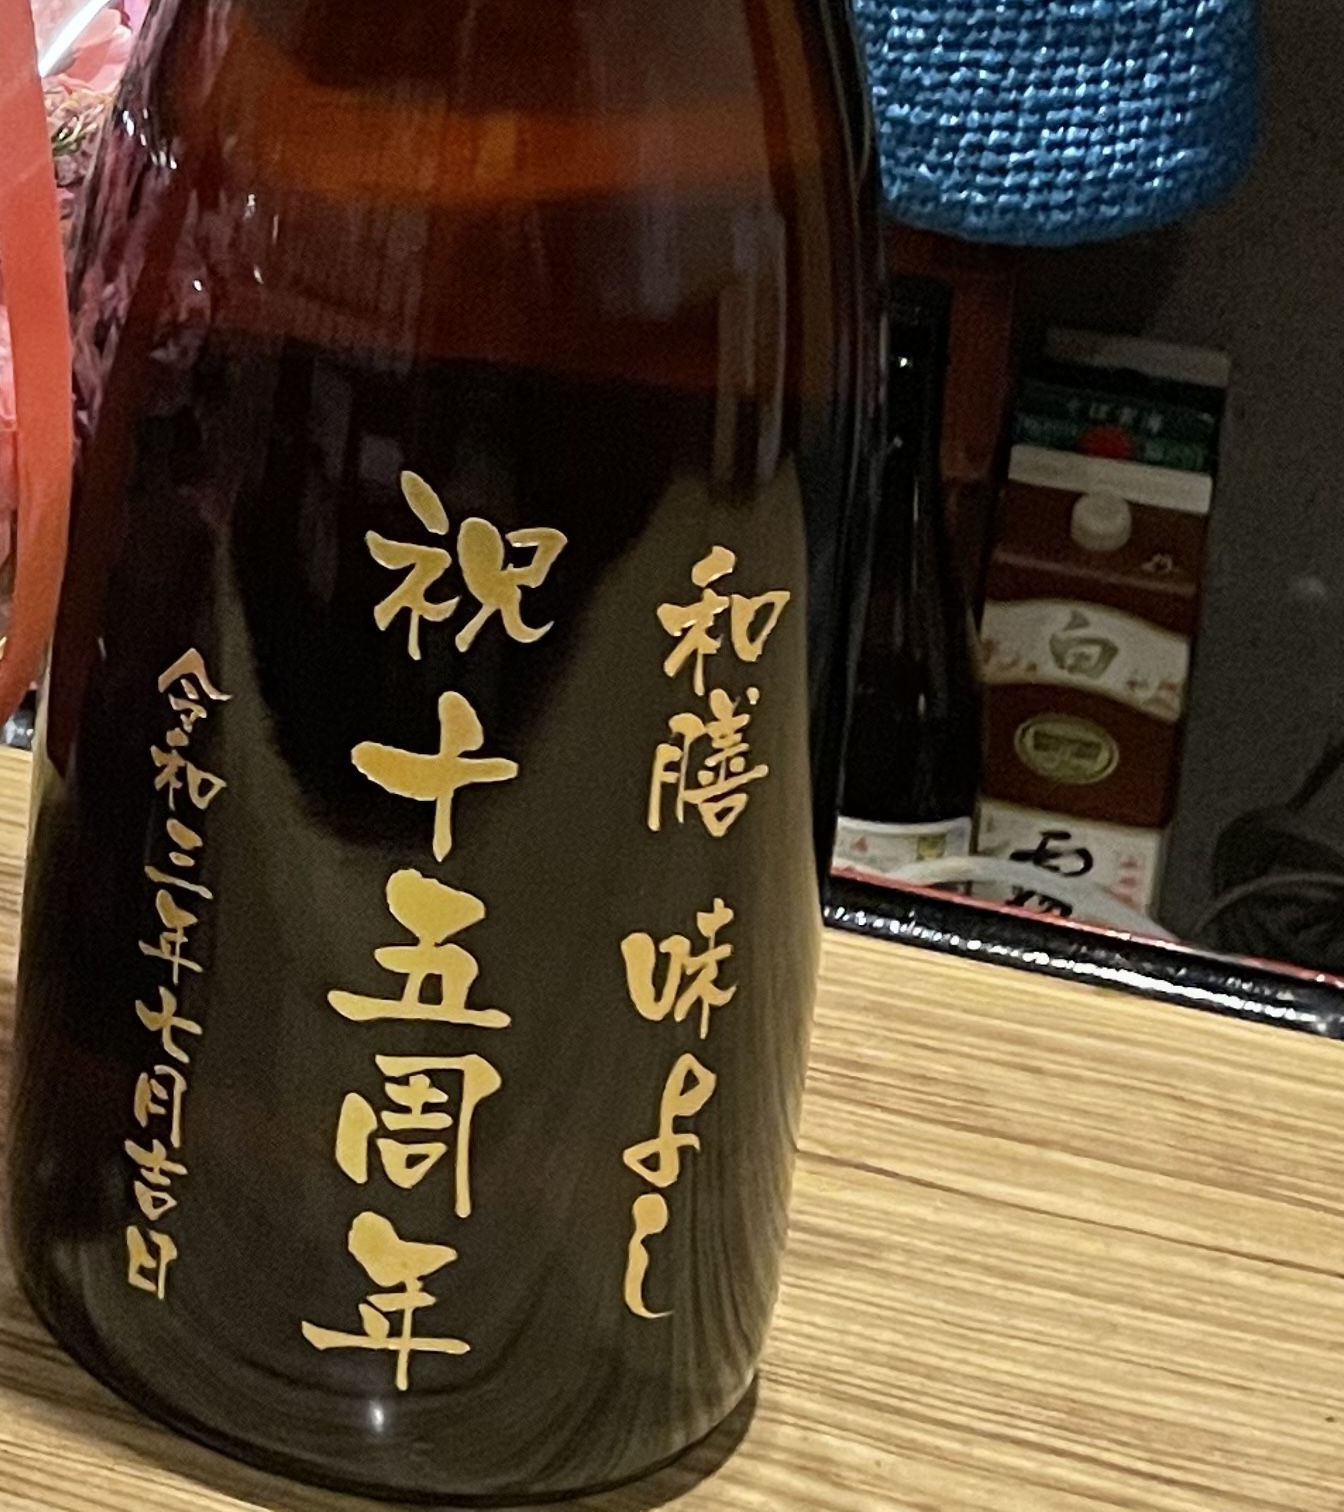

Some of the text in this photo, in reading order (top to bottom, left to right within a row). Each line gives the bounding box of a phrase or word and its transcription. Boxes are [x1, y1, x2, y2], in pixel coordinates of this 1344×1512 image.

[124, 647, 233, 1300] 令和三年七月吉日
[301, 471, 567, 1390] 祝十五周年
